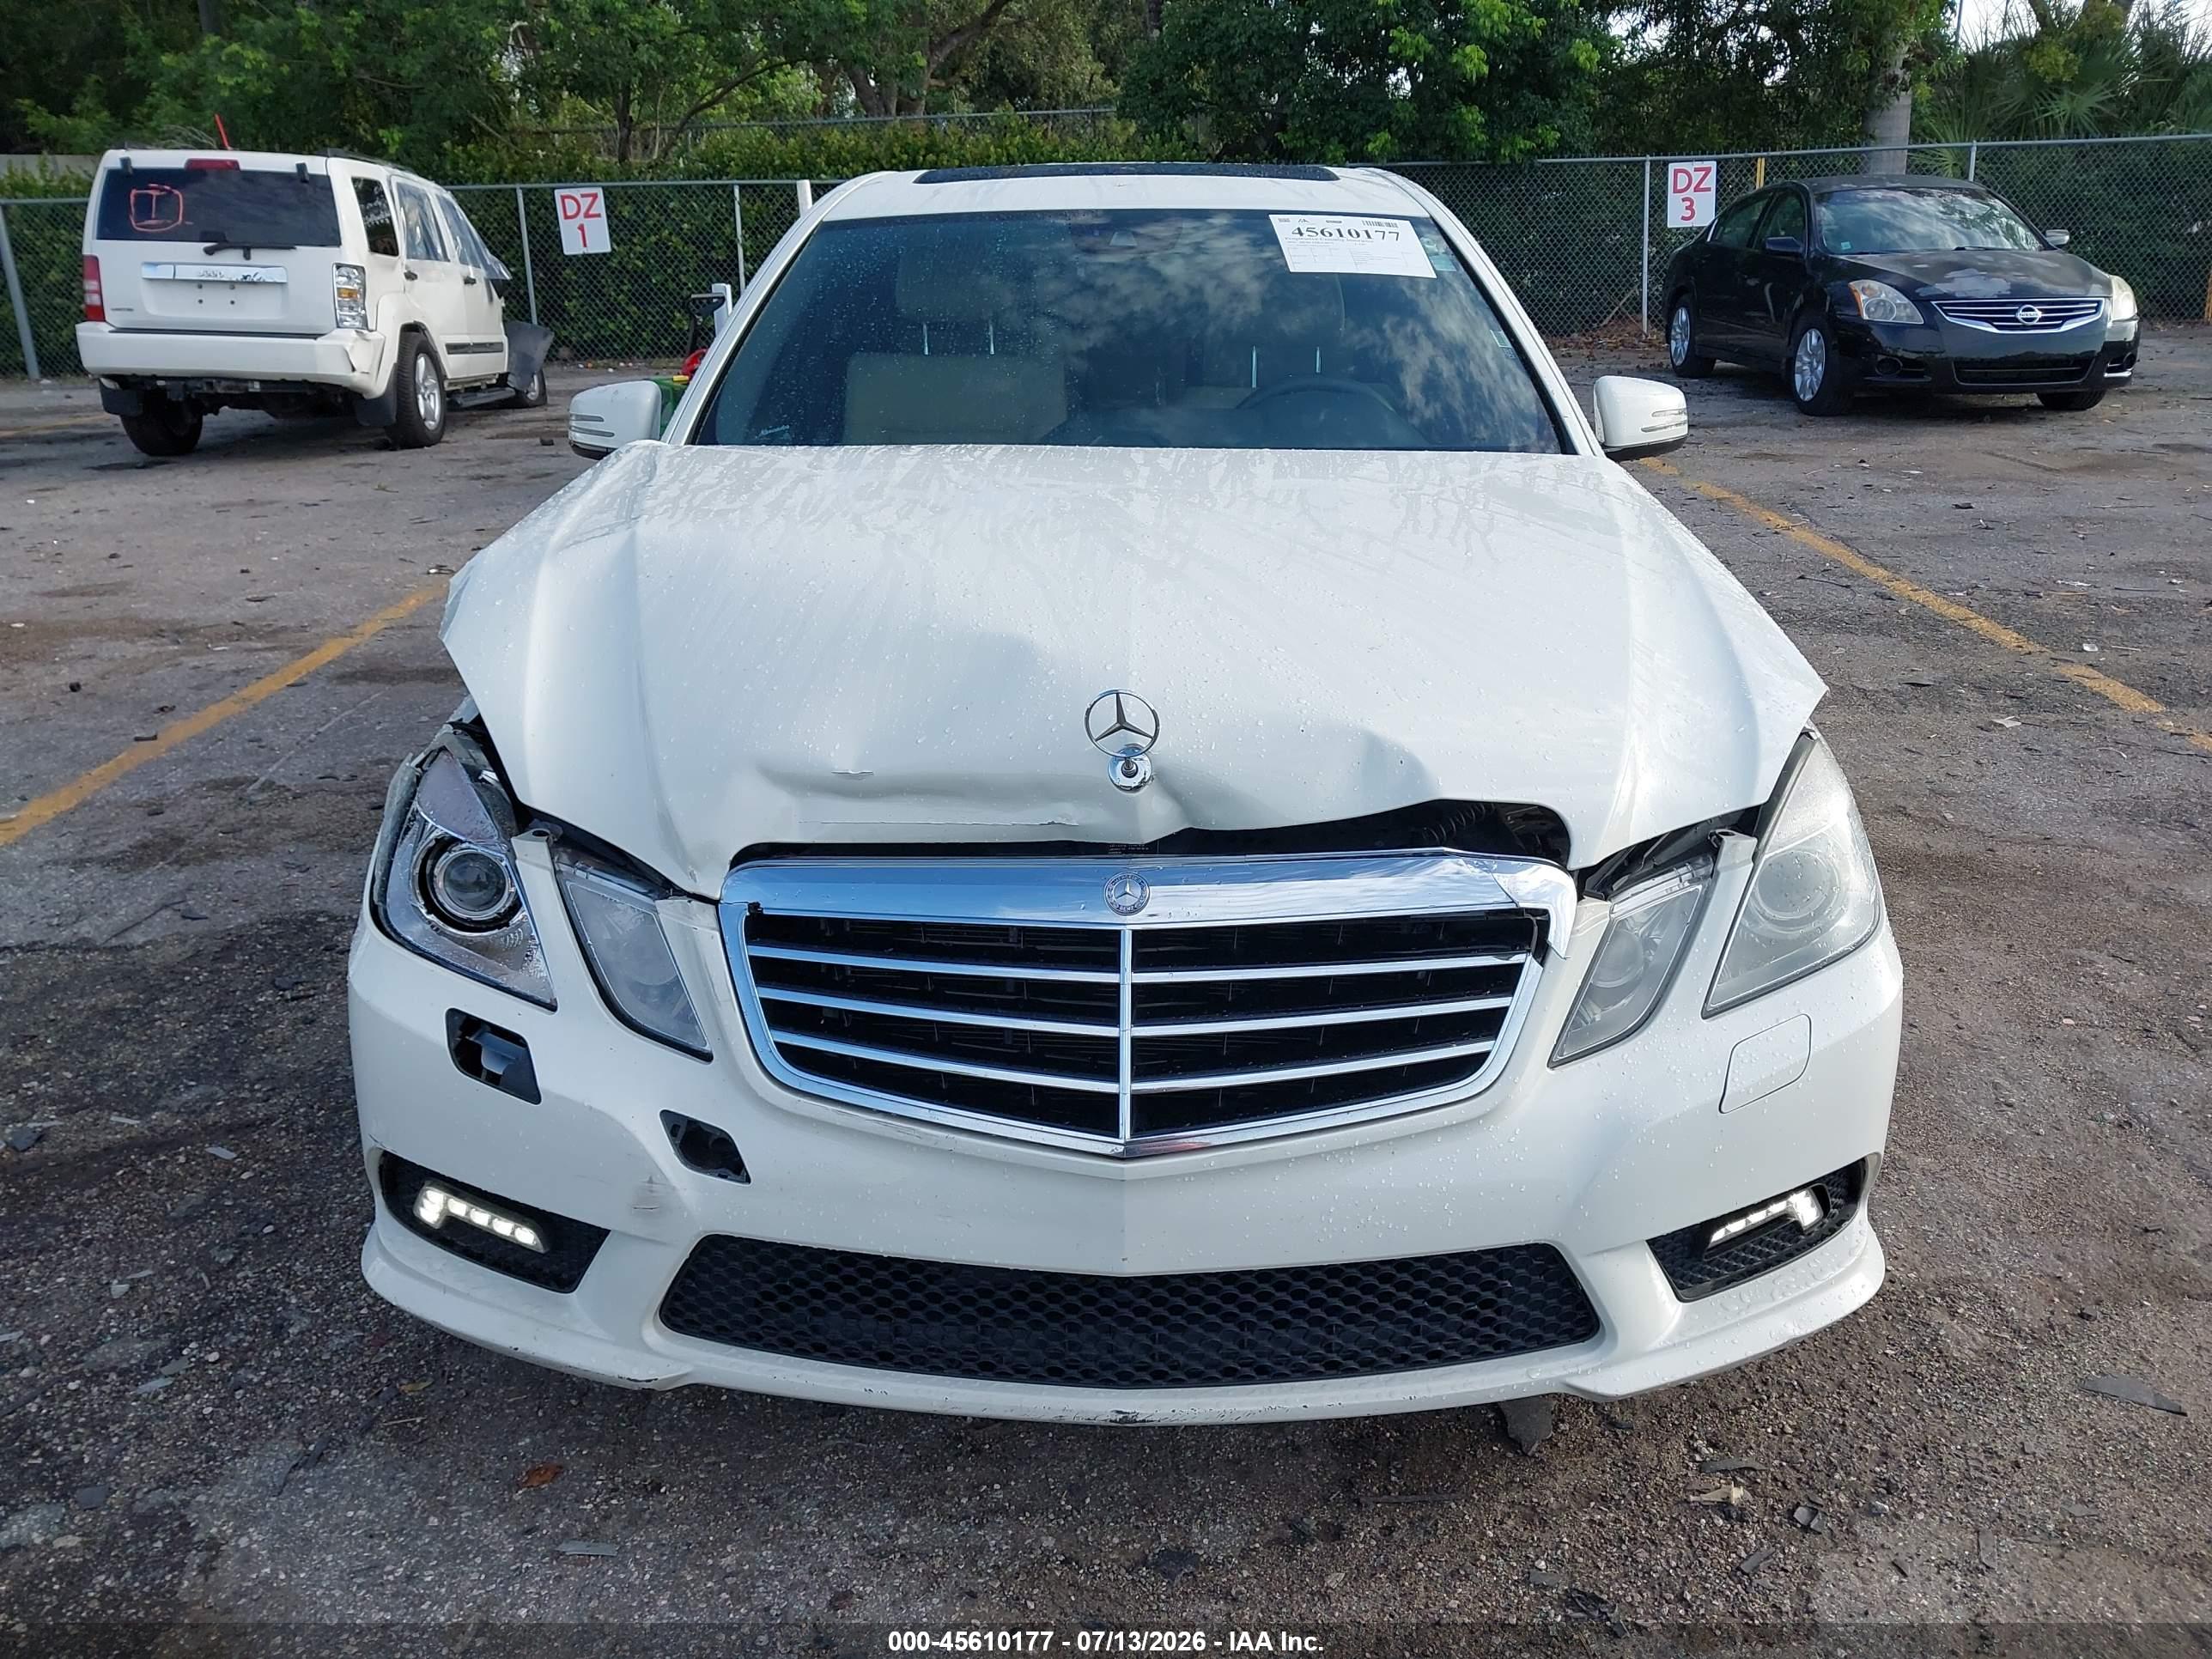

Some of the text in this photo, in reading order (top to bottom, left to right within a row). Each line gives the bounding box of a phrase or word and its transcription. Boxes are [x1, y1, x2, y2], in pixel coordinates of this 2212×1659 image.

[1673, 166, 1712, 194] DZ
[560, 192, 602, 220] DZ
[1680, 197, 1696, 222] 3
[577, 223, 587, 248] 1
[1291, 226, 1400, 241] 45610177
